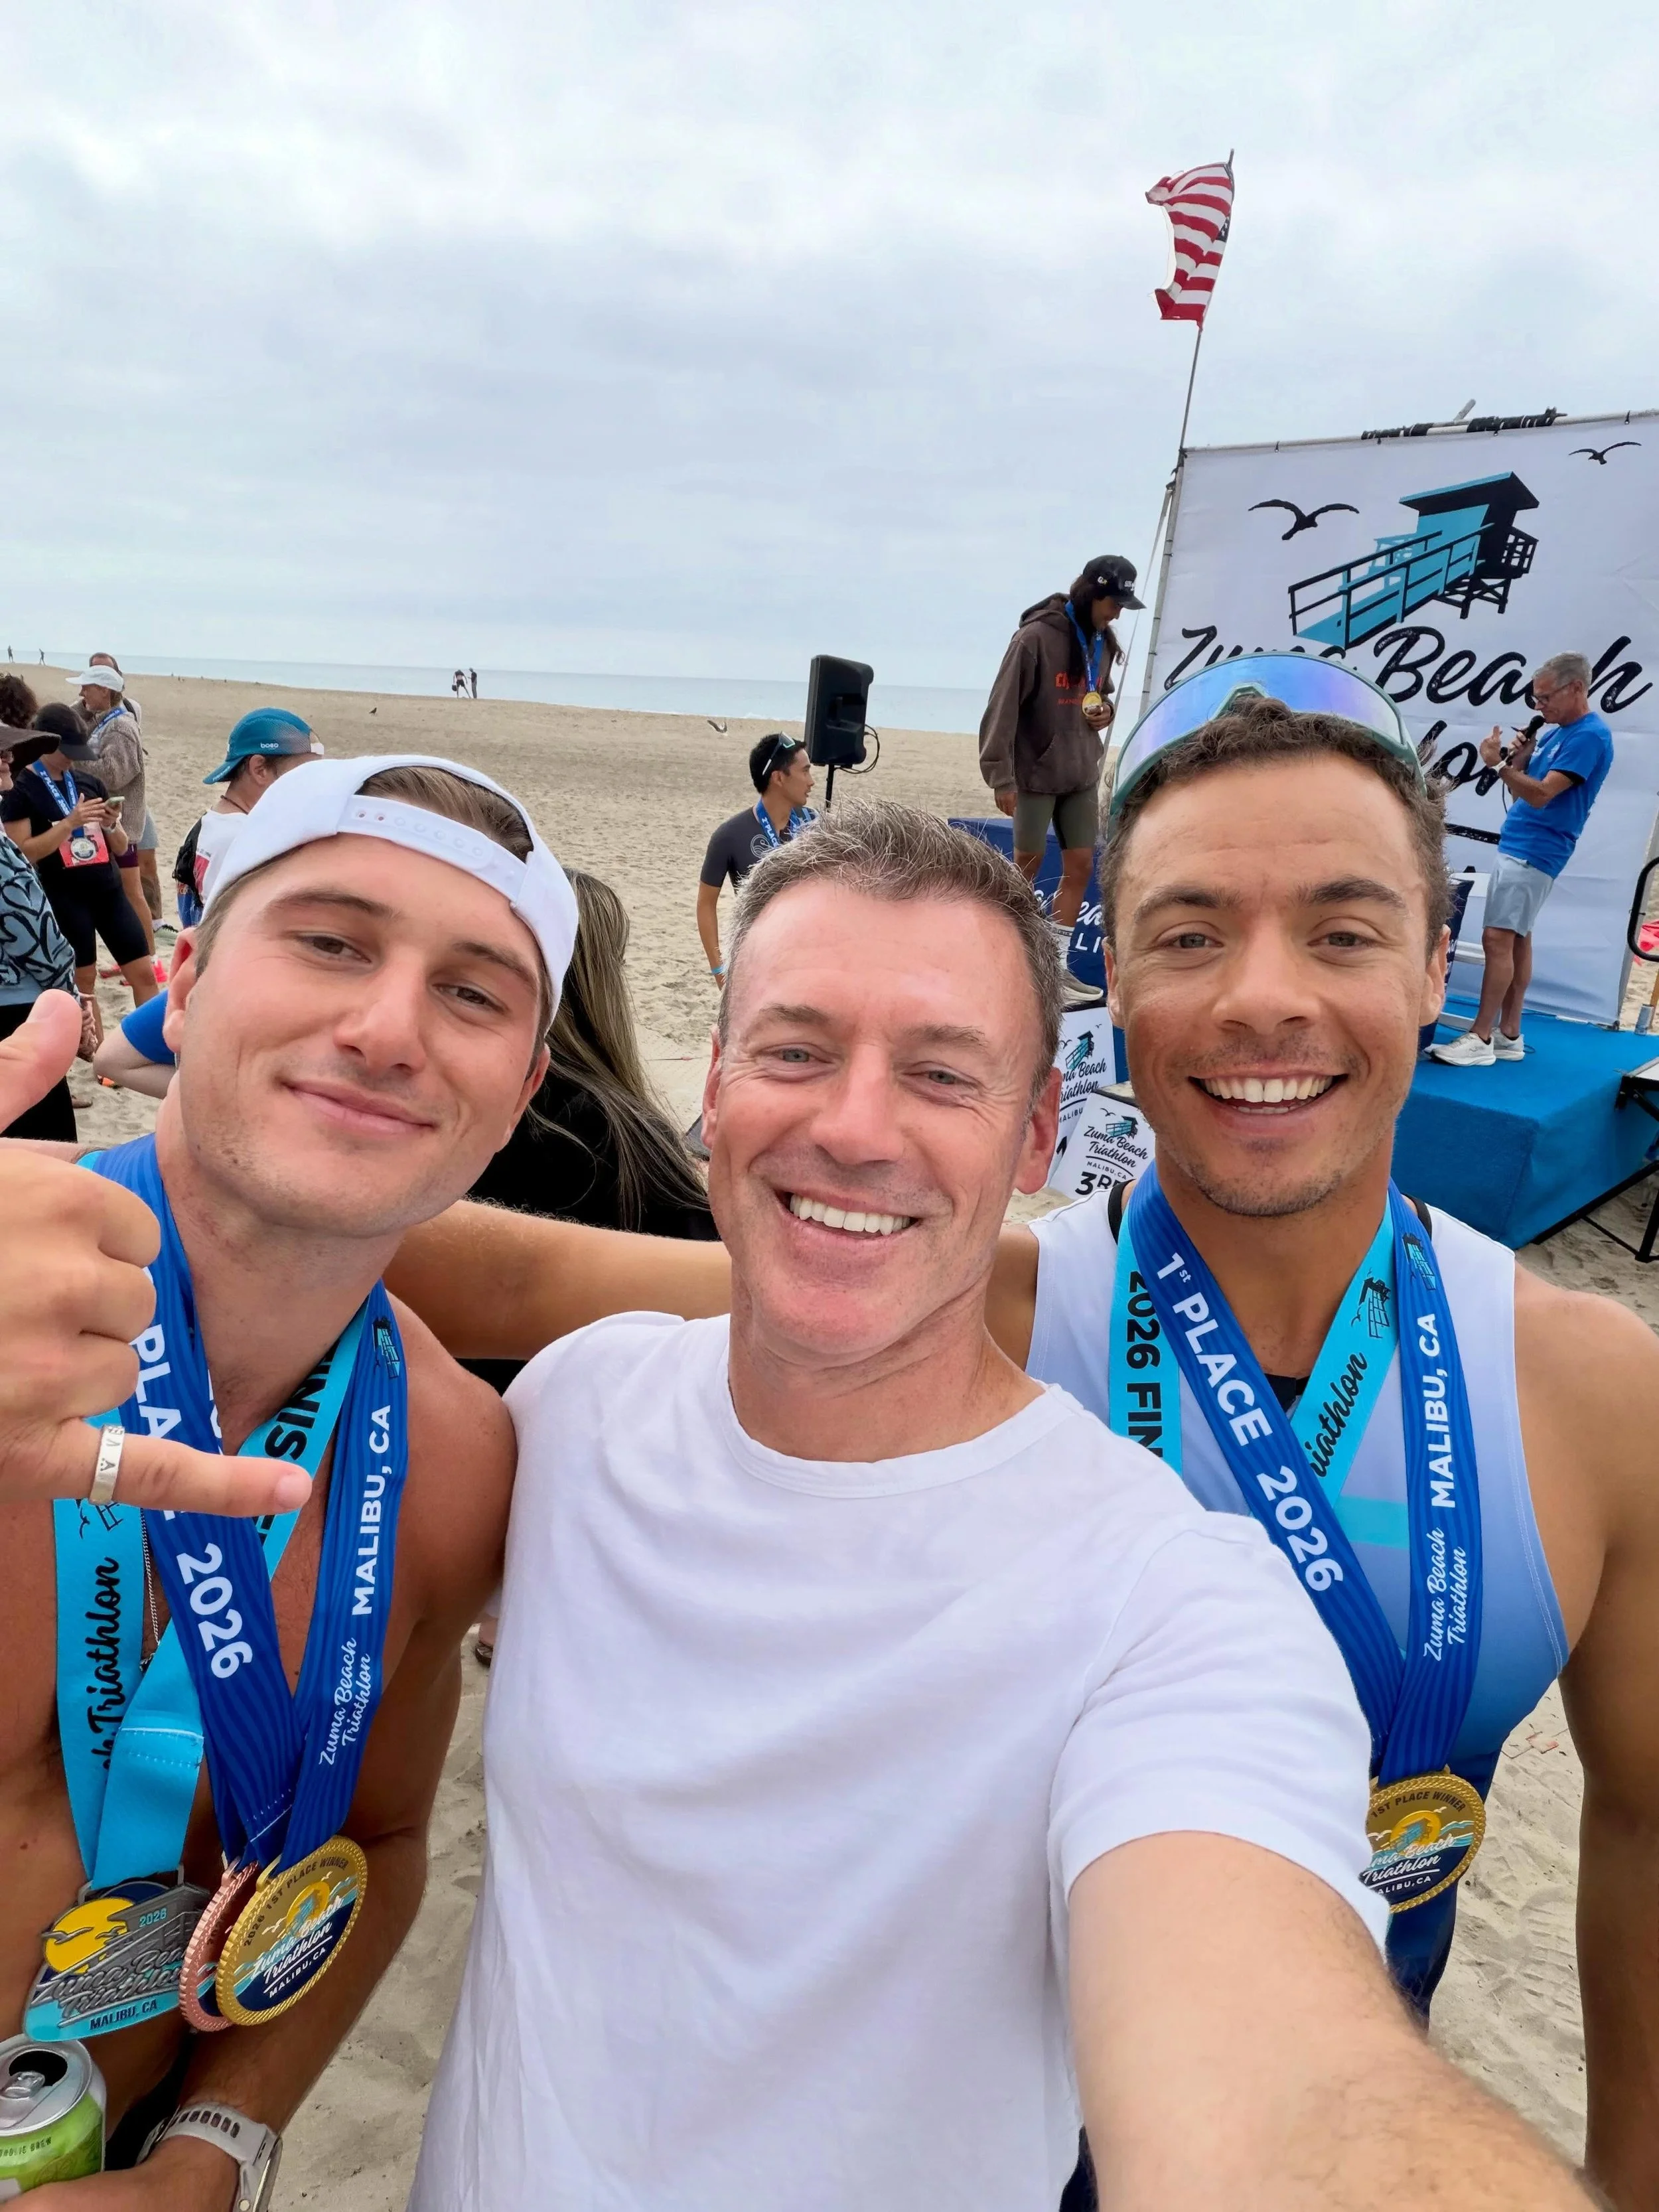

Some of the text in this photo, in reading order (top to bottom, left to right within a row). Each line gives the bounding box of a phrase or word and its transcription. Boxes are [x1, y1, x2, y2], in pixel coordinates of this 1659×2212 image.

[764, 824, 779, 848] PLACE
[1060, 1079, 1099, 1104] riathlon
[1078, 1058, 1107, 1077] Beach
[1084, 1125, 1149, 1160] Zuma Beach
[1089, 1141, 1137, 1168] Triathlon
[1126, 1270, 1161, 1369] 2026
[1156, 1252, 1344, 1592] 1st PLACE 2026
[1418, 1313, 1456, 1508] MALIBU, CA
[351, 1404, 392, 1617] MALIBU, CA
[175, 1542, 254, 1680] 2026
[1423, 1526, 1448, 1662] Zuma Beach
[1447, 1546, 1467, 1645] Triathlon
[85, 1556, 126, 1728] Triathlon
[318, 1637, 357, 1766] Zuma Beach
[341, 1653, 372, 1748] Triathlon
[1371, 1791, 1467, 1818] 1ST PLACE WINNER
[1404, 1833, 1456, 1858] Beach
[244, 1915, 265, 1947] 2026
[266, 1889, 283, 1909] 1ST
[286, 1861, 317, 1889] PLACE
[319, 1856, 350, 1870] WINNER
[1362, 1855, 1441, 1883] Triathlon
[31, 1948, 183, 2006] Zuma Bea
[251, 1895, 344, 1980] Zuma Beach
[263, 1921, 332, 1984] Triathlon
[90, 1999, 158, 2031] MALIBU, CA
